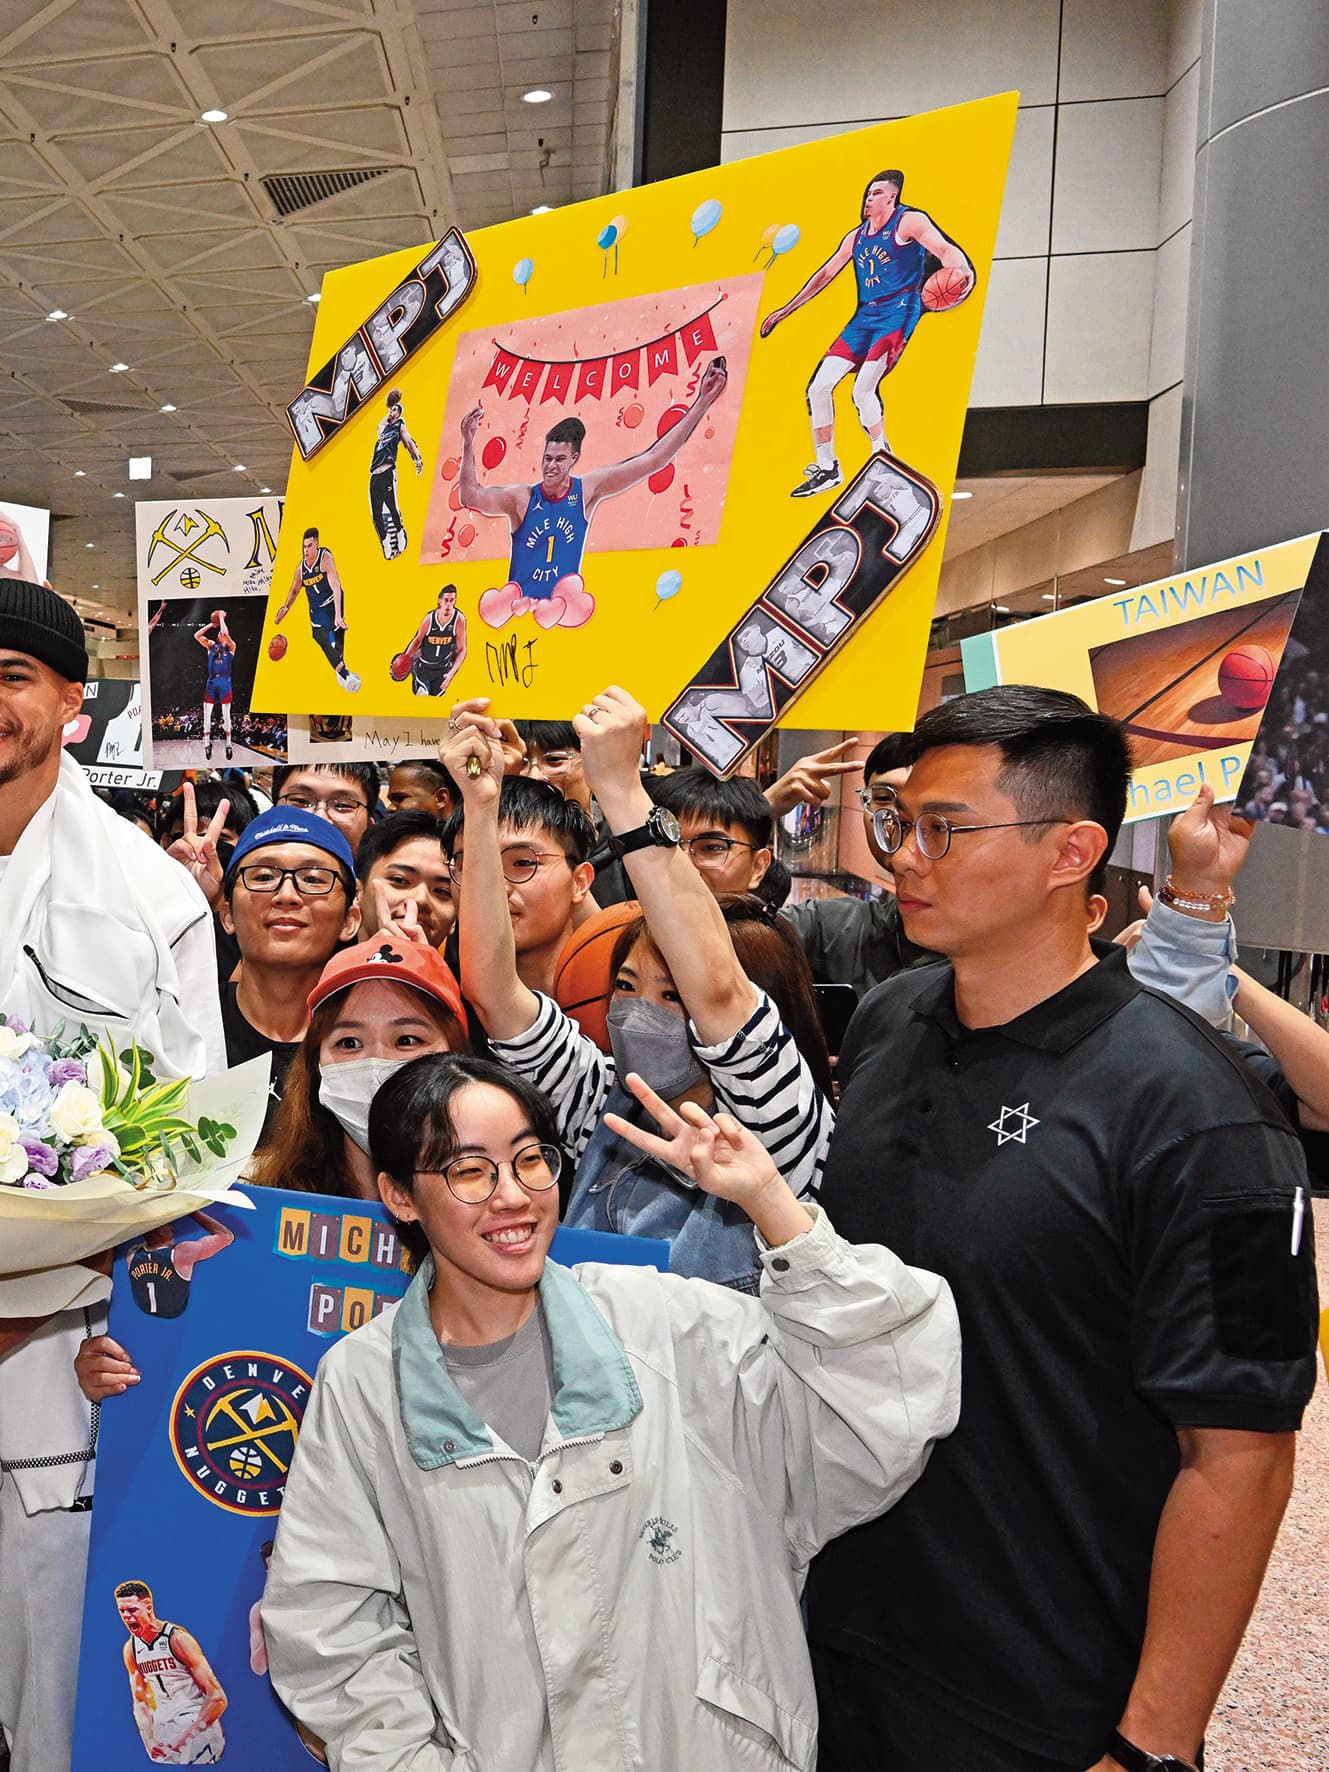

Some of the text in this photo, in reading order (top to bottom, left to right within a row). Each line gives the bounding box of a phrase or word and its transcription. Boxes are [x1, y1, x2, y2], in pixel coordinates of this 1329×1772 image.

[869, 258, 875, 275] 1
[285, 228, 475, 459] MPJ
[494, 329, 704, 390] WELCOME
[526, 517, 574, 548] MILE HIGH
[546, 536, 555, 562] 1
[532, 566, 559, 581] CITY
[1113, 560, 1265, 625] TAIWAN
[662, 455, 937, 772] MPJ
[436, 645, 441, 657] 1
[364, 729, 441, 755] May I have
[136, 773, 157, 788] Jr.
[1220, 756, 1241, 788] P
[131, 1262, 159, 1280] PORTER
[146, 1282, 157, 1313] 1
